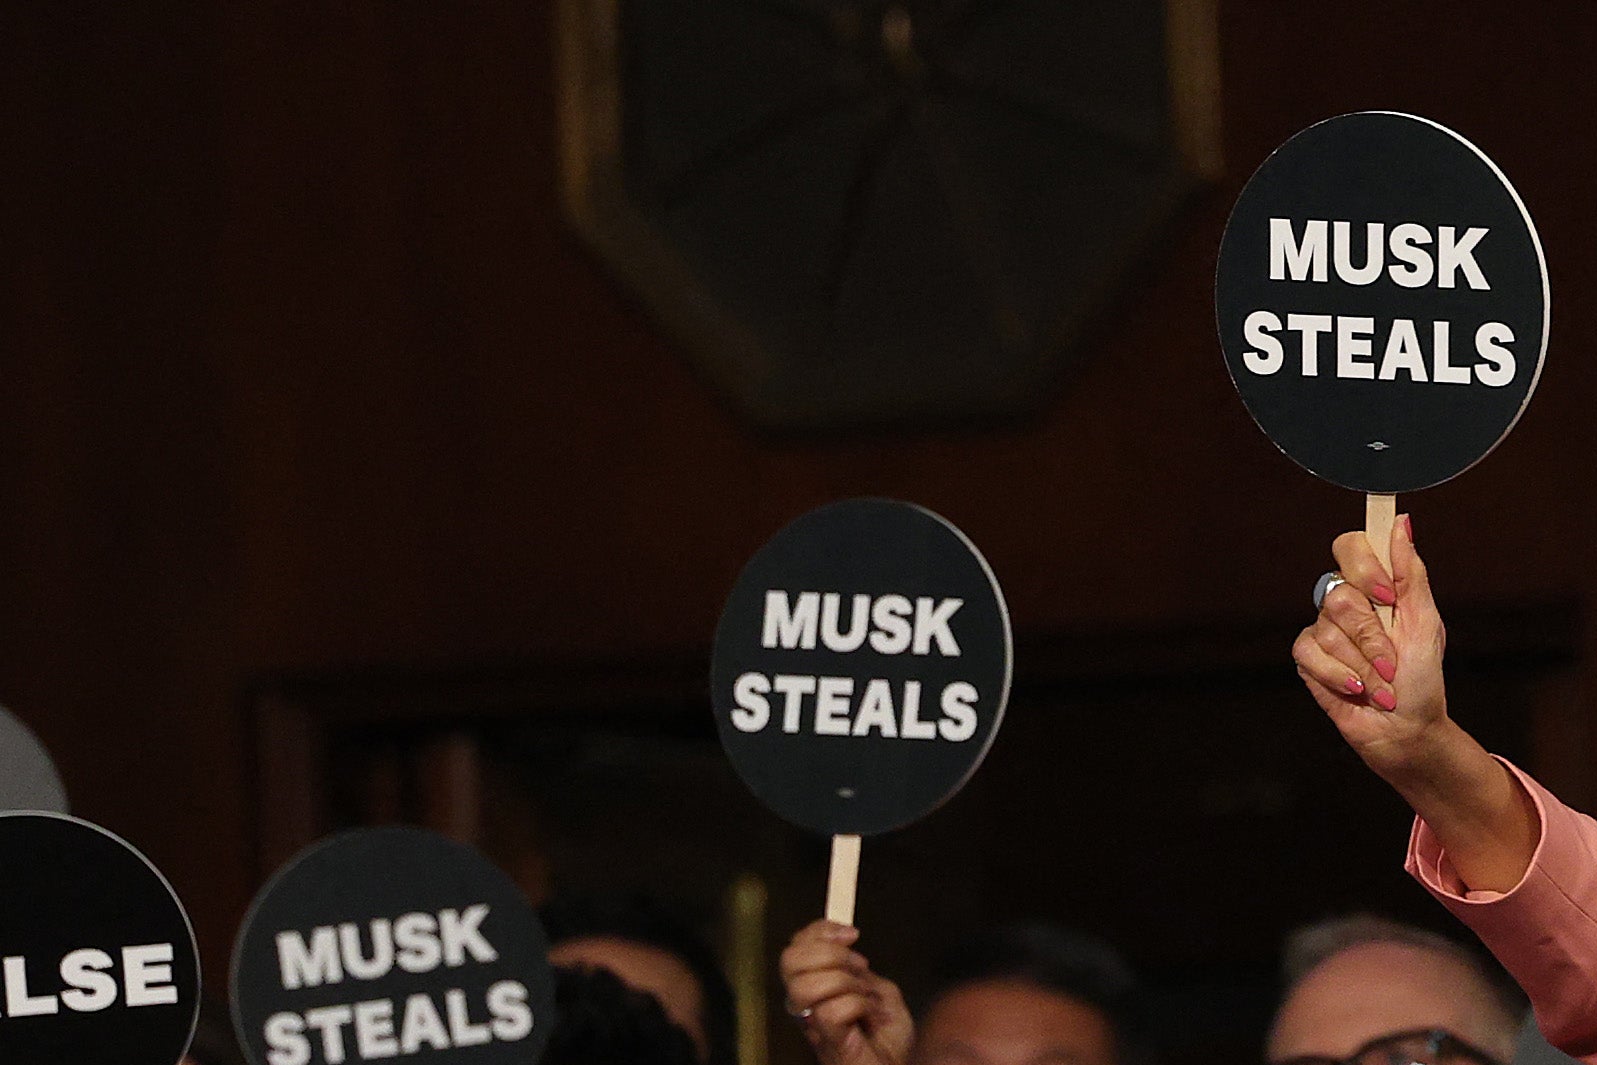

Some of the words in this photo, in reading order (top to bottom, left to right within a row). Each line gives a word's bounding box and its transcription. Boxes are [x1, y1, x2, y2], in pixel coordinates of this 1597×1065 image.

[1269, 217, 1491, 290] MUSK
[1242, 310, 1516, 387] STEALS
[762, 590, 964, 657] MUSK
[730, 672, 979, 742] STEALS
[0, 942, 178, 1018] LSE
[275, 903, 499, 990] MUSK
